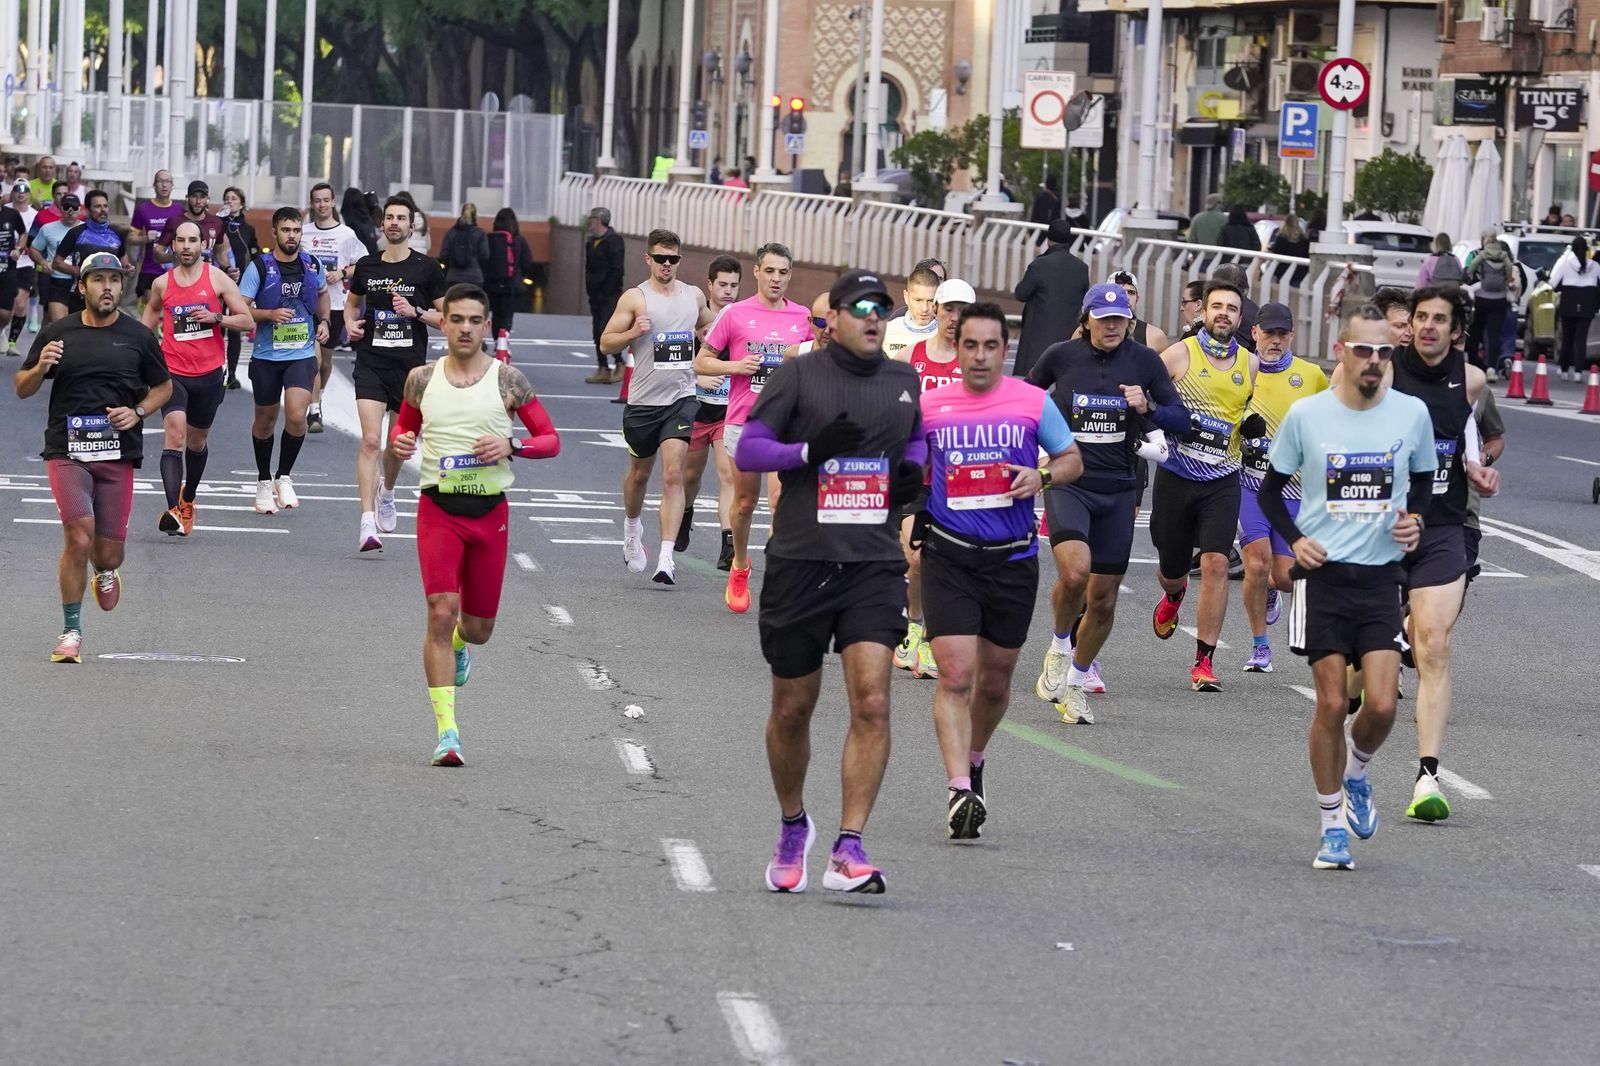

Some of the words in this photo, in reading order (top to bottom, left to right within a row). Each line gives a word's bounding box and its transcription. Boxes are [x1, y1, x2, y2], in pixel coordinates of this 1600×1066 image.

[1402, 67, 1432, 78] LUIS
[1520, 91, 1577, 106] TINTE
[1286, 107, 1309, 136] P
[367, 278, 394, 287] Sports
[184, 323, 201, 332] JAVI
[382, 330, 404, 339] JORDI
[669, 352, 682, 360] ALI
[1091, 398, 1120, 406] ZURICH
[1081, 422, 1116, 432] JAVIER
[1202, 418, 1228, 430] ZURICH
[934, 421, 1025, 450] VILLALÓN
[68, 440, 120, 452] FREDERICO
[1204, 445, 1227, 457] ROVIRA
[967, 452, 1003, 462] ZURICH
[1350, 456, 1388, 465] ZURICH
[844, 461, 881, 471] ZURICH
[460, 474, 477, 482] 2657
[453, 483, 487, 494] NEIRA
[1340, 486, 1382, 498] GOTYF
[824, 493, 885, 508] AUGUSTO
